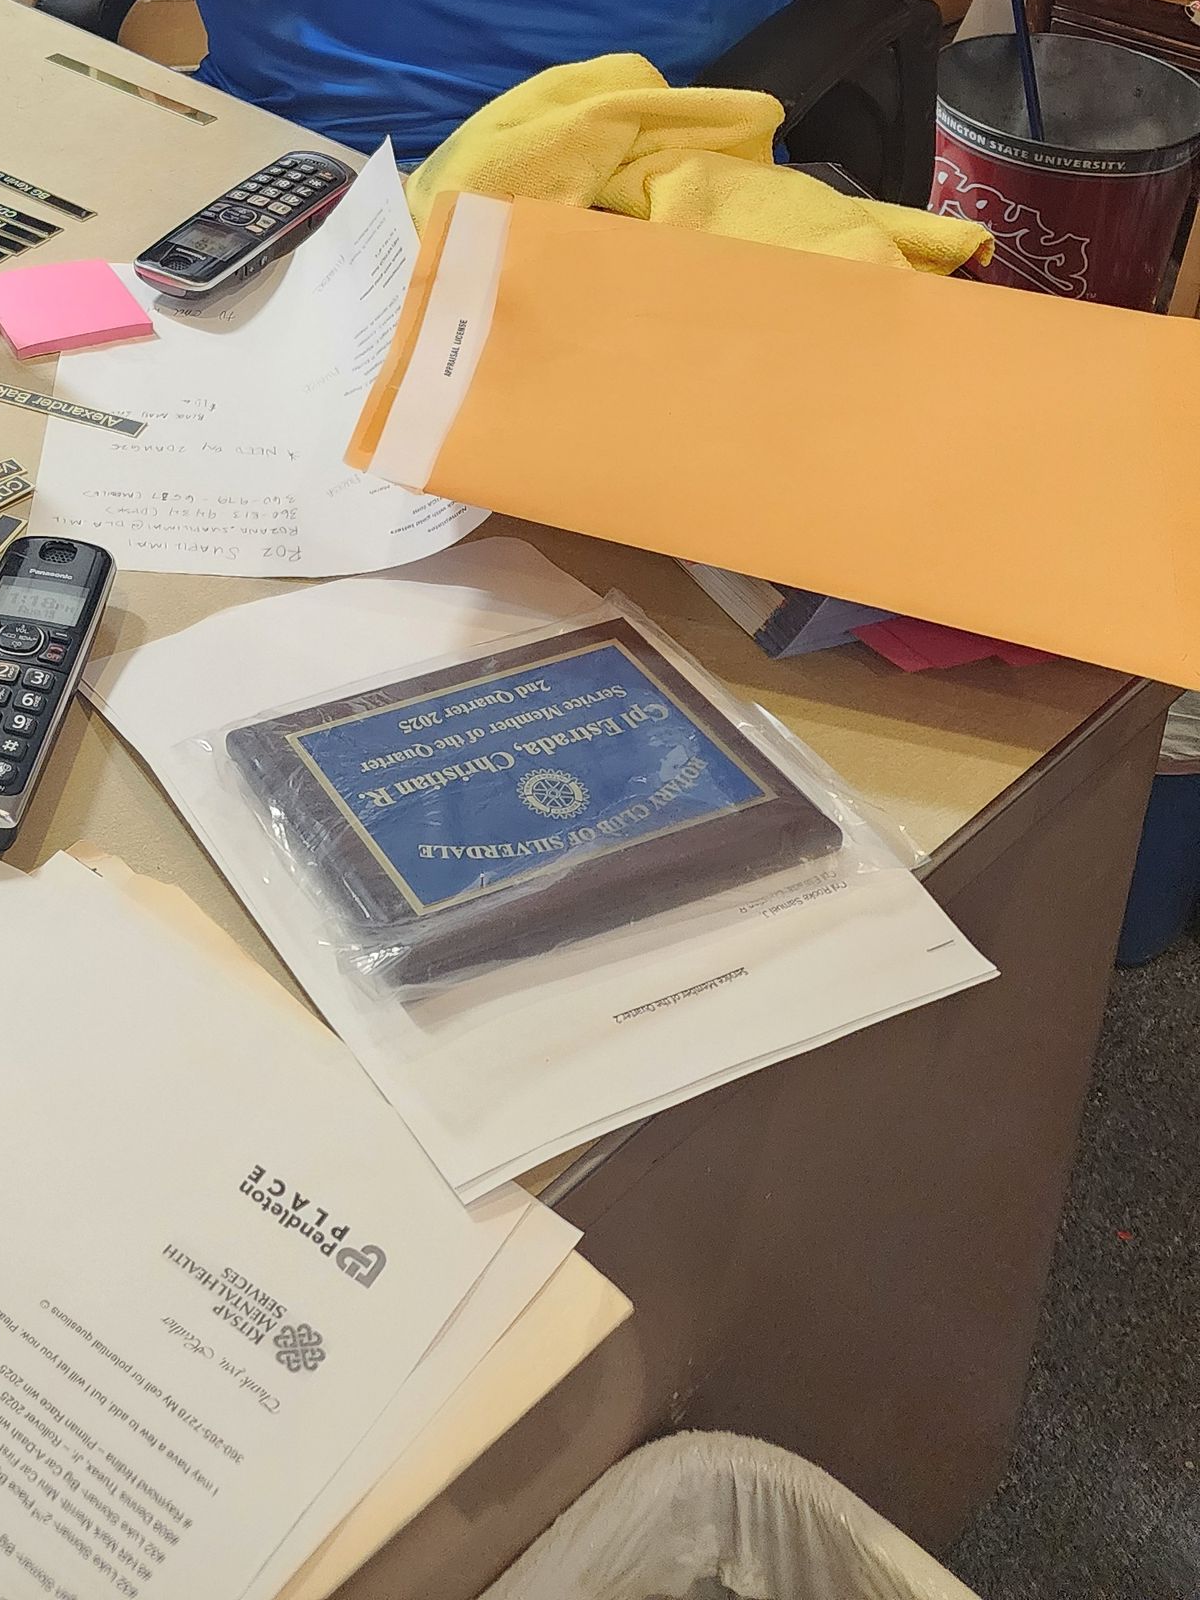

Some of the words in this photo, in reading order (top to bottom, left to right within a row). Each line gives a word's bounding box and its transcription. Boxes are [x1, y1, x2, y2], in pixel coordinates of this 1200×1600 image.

[988, 140, 1030, 162] STATE
[1034, 153, 1125, 171] UNIVERSITY
[3, 176, 31, 191] Kevin
[30, 189, 50, 199] BG
[444, 347, 459, 376] APPRAISAL
[454, 319, 467, 344] LICENSE
[32, 397, 121, 426] Alexander
[28, 566, 73, 581] Panasonic
[29, 669, 44, 685] 3
[514, 679, 549, 697] 2nd
[564, 685, 626, 709] Service
[20, 691, 34, 707] 6
[444, 690, 513, 716] Quarter
[11, 713, 27, 730] 9
[398, 711, 442, 733] 2025
[489, 705, 562, 732] Member
[622, 703, 668, 727] Cpl
[434, 734, 464, 748] the
[465, 728, 484, 744] of
[514, 718, 621, 754] Estrada,
[361, 744, 432, 772] Quarter
[395, 752, 513, 794] Christian
[649, 758, 705, 804] ROTARY
[358, 786, 395, 812] R.
[596, 804, 649, 835] CLUB
[568, 827, 595, 845] OF
[418, 833, 563, 858] SILVERDALE
[715, 967, 748, 983] Service
[669, 992, 680, 1002] of
[680, 979, 717, 997] Member
[621, 1001, 655, 1019] Quarter
[654, 996, 670, 1006] the
[240, 1181, 336, 1255] Pendleton
[221, 1267, 286, 1318] SERVICES
[51, 1306, 92, 1340] questions
[212, 1305, 264, 1344] KITSAP
[162, 1317, 214, 1357] Heather
[39, 1346, 58, 1362] you
[91, 1340, 132, 1372] potential
[55, 1360, 70, 1374] let
[67, 1371, 85, 1386] will
[131, 1371, 145, 1385] for
[89, 1388, 107, 1405] but
[143, 1381, 162, 1397] cell
[239, 1376, 279, 1412] Thank
[162, 1395, 178, 1412] My
[128, 1419, 139, 1431] to
[139, 1428, 157, 1446] few
[166, 1450, 190, 1473] have
